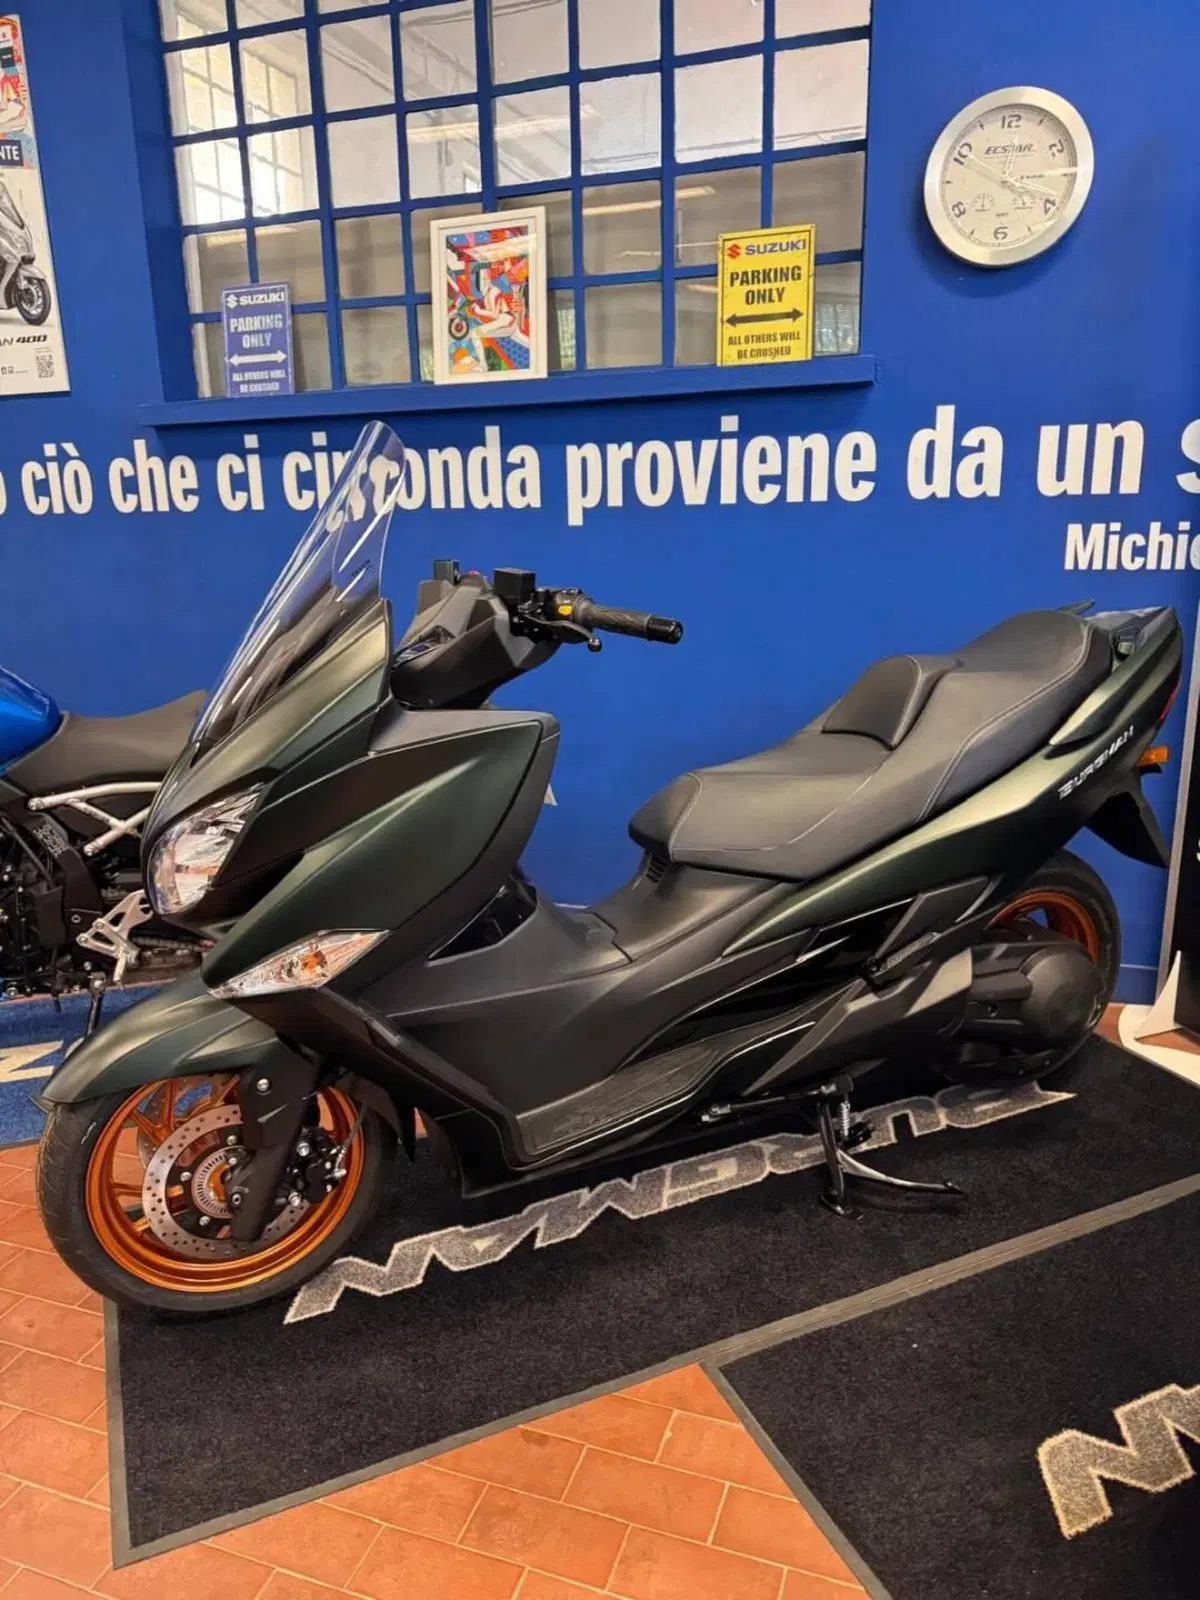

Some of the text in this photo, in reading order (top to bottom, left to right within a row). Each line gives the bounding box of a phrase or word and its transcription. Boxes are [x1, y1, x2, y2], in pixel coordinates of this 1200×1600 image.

[1000, 114, 1022, 129] 12
[952, 141, 974, 167] 10
[1048, 138, 1066, 160] 2
[951, 200, 967, 219] 8
[1042, 197, 1057, 215] 4
[993, 226, 1009, 241] 6
[745, 238, 807, 256] SUZUKI
[729, 265, 802, 288] PARKING
[239, 291, 285, 306] SUZUKI
[745, 287, 786, 306] ONLY
[230, 314, 283, 333] PARKING
[15, 334, 48, 345] 400
[242, 333, 272, 349] ONLY
[728, 330, 801, 346] ALL OTHERS WILL
[750, 346, 791, 359] CRUSHED
[21, 442, 93, 515] ciò
[108, 439, 199, 513] che
[216, 434, 265, 511] ci
[565, 415, 877, 526] proviene
[907, 404, 1004, 500] da
[1036, 420, 1145, 497] un
